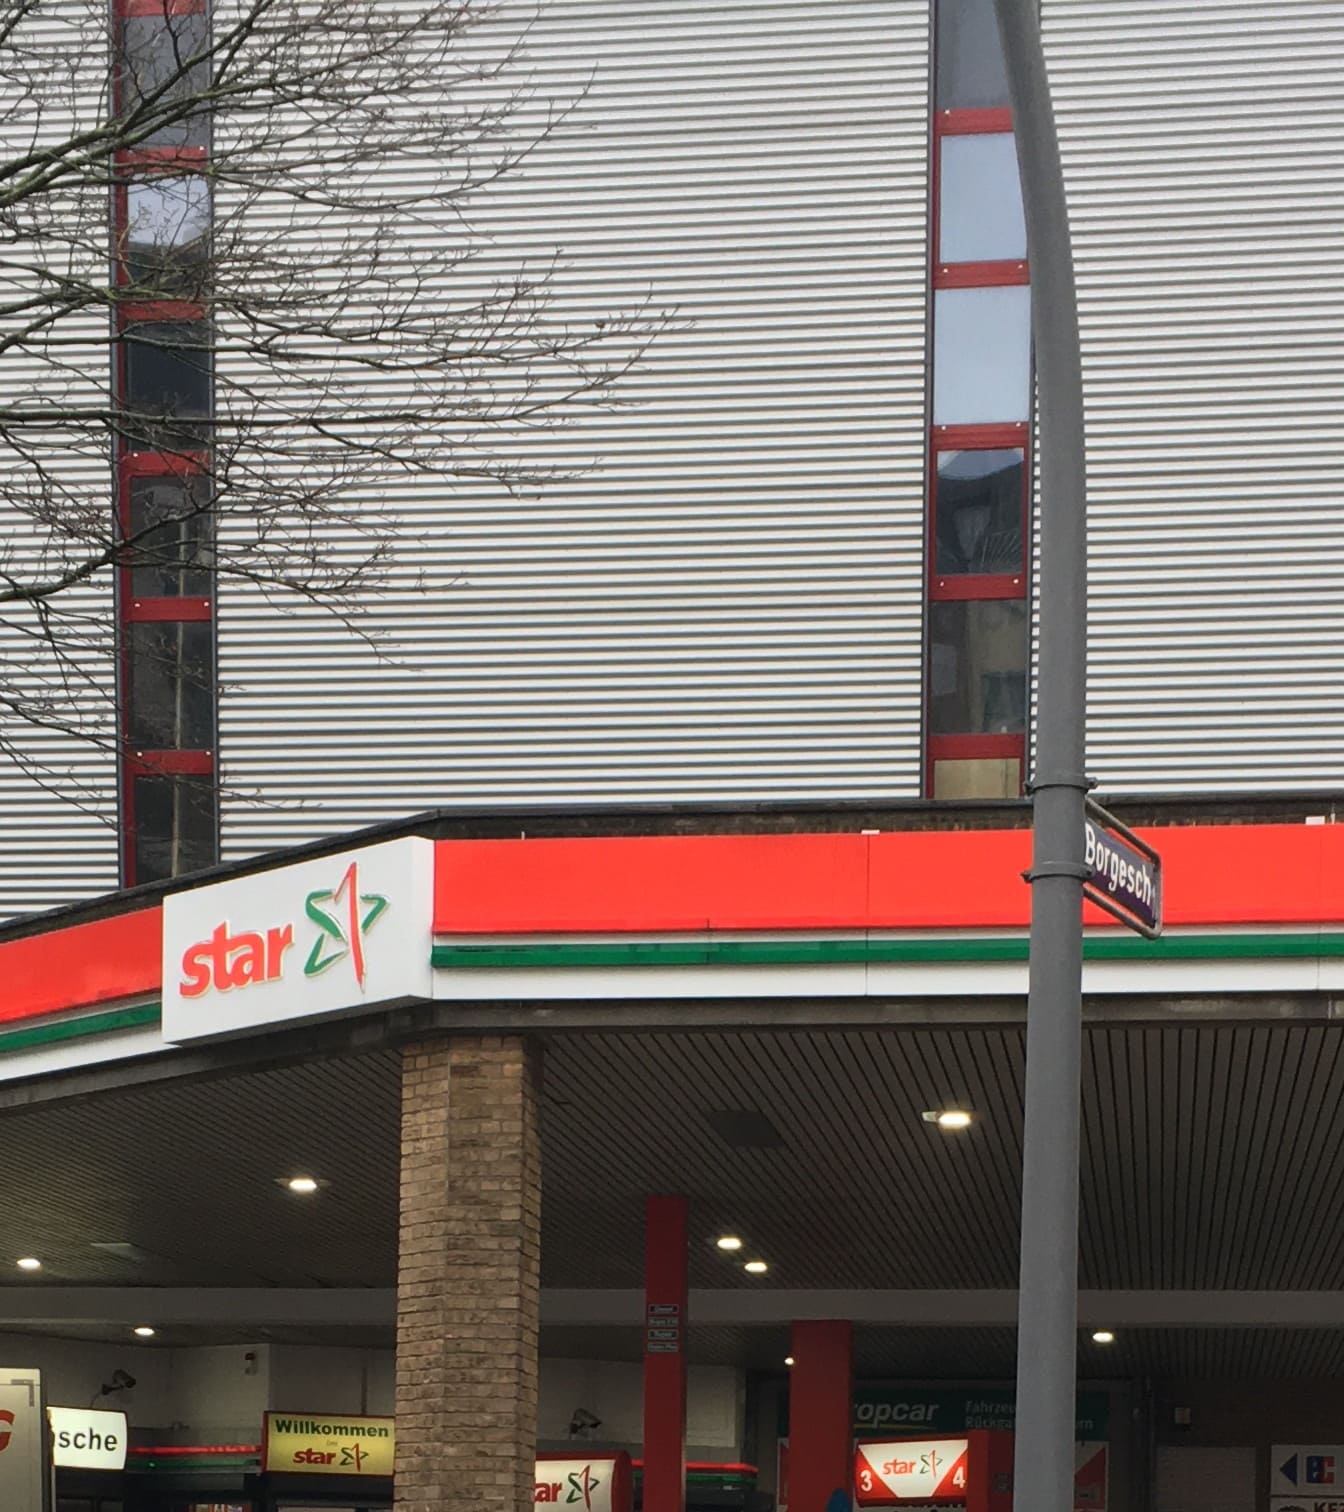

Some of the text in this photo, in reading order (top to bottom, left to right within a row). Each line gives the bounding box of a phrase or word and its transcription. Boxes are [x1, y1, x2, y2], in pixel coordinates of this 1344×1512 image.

[1085, 822, 1151, 906] Borgesch
[179, 920, 294, 998] star
[854, 1400, 939, 1428] opcar
[54, 1427, 118, 1452] sche
[276, 1419, 389, 1438] Willkommen
[292, 1448, 337, 1465] star
[882, 1458, 917, 1476] star
[860, 1469, 873, 1492] 3
[952, 1467, 966, 1489] 4
[534, 1482, 563, 1504] ar
